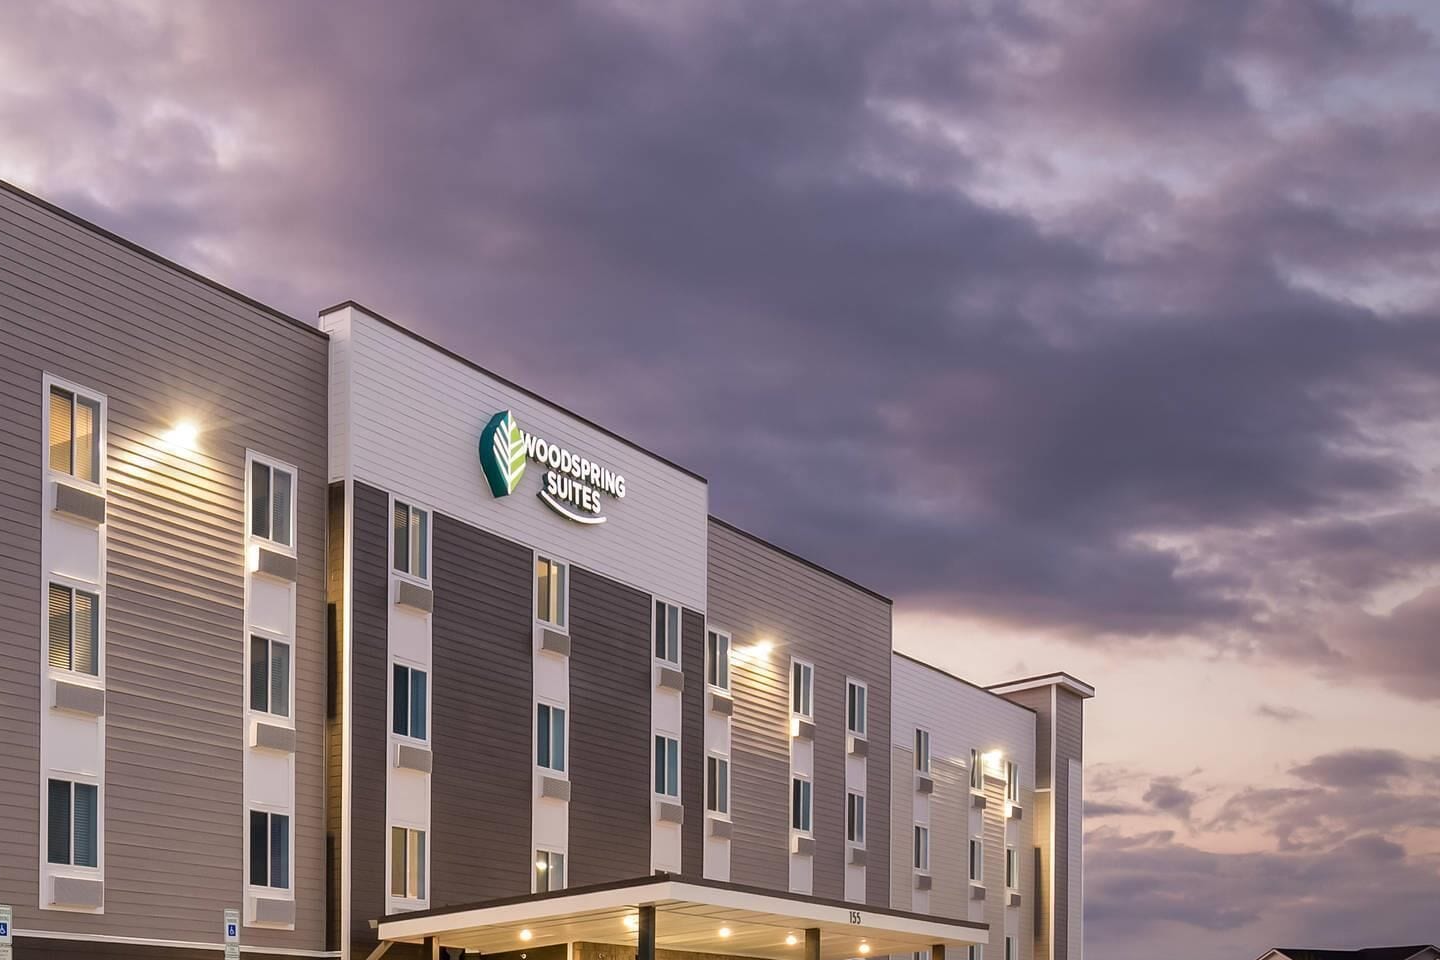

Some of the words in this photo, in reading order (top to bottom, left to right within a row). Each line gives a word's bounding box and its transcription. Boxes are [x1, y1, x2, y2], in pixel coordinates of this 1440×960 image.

[520, 430, 626, 498] WOODSPRING
[547, 471, 601, 514] SUITES
[849, 911, 861, 925] 155
